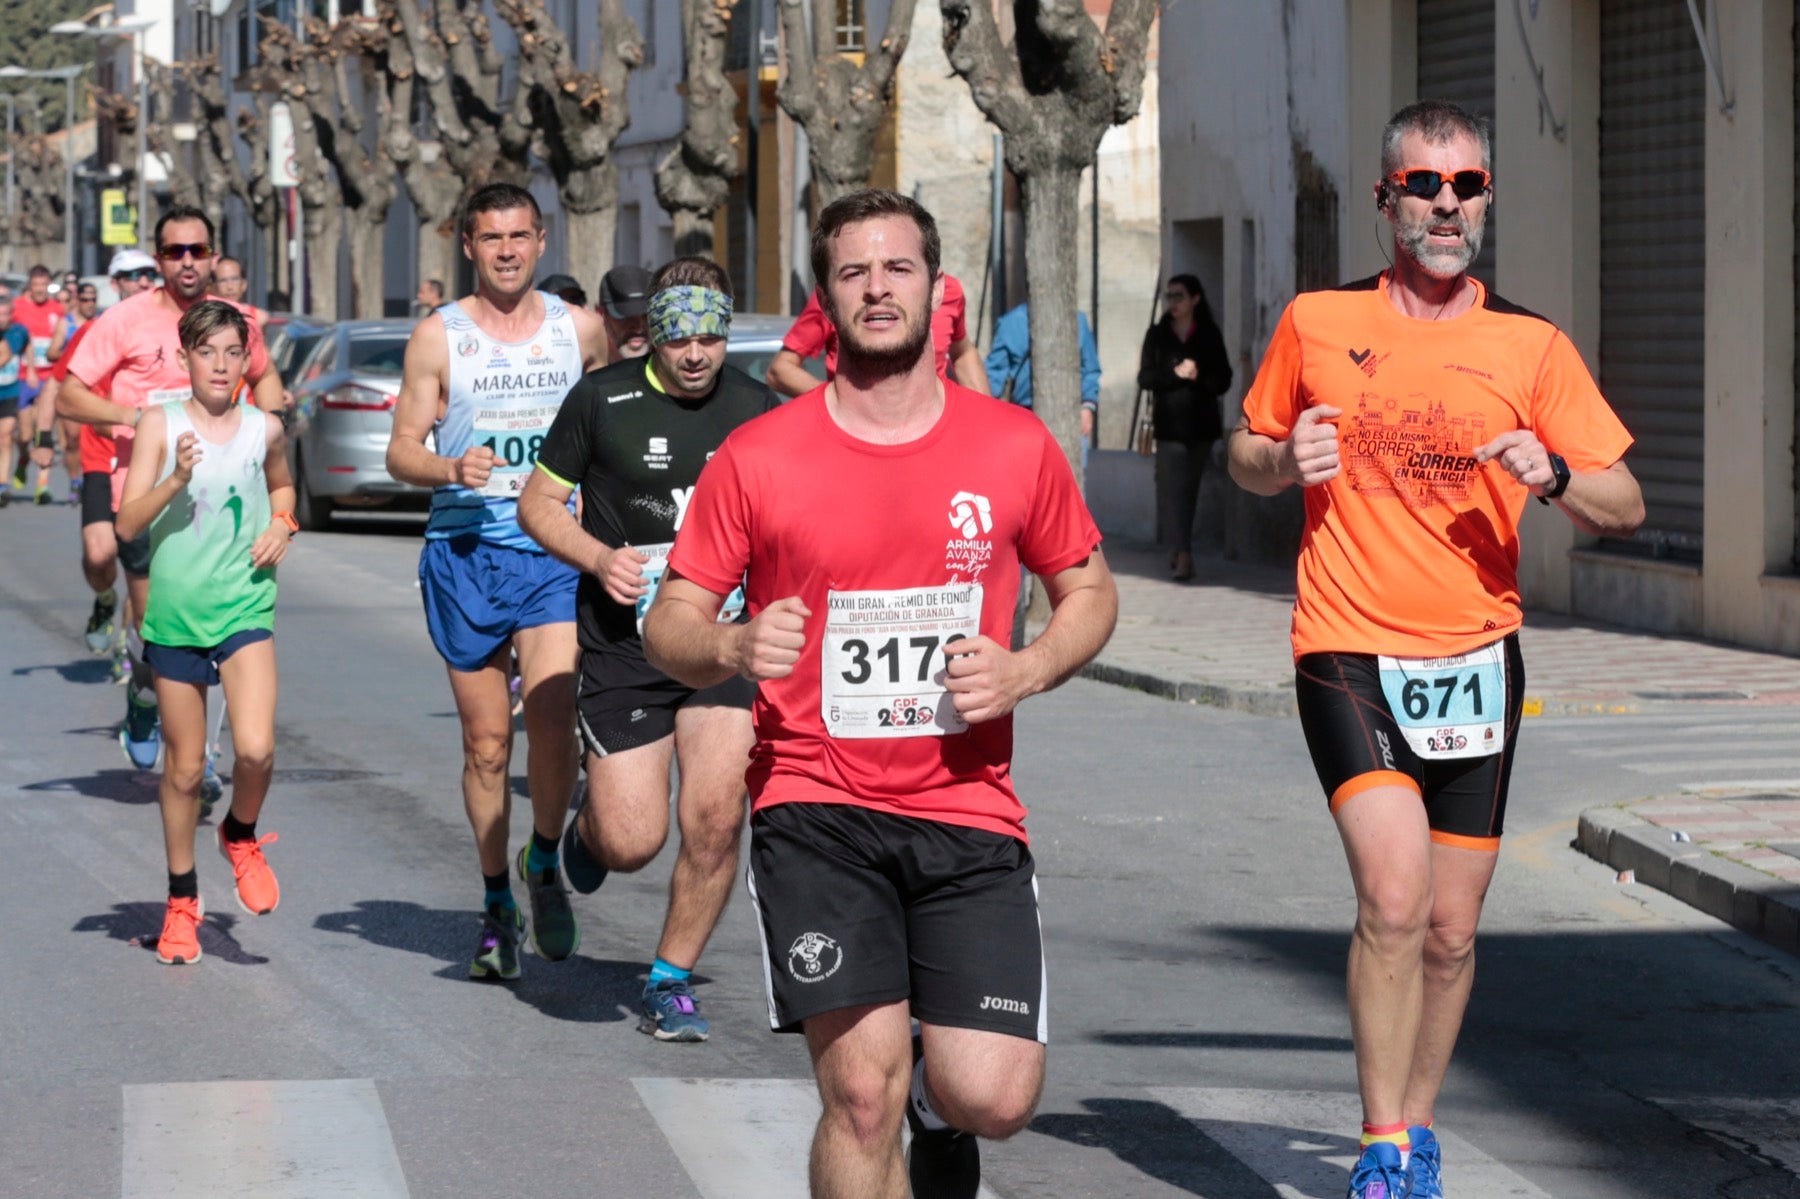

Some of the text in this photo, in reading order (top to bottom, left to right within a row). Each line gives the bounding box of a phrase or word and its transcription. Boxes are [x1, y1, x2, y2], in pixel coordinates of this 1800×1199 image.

[1456, 365, 1493, 380] BROOKS
[472, 370, 568, 393] MARACENA
[1358, 430, 1430, 442] NO ES LO MISMO
[1357, 440, 1416, 457] CORRER
[643, 454, 673, 462] SEAT
[1407, 452, 1478, 472] CORRER
[1394, 468, 1468, 482] EN VALENCIA
[946, 539, 992, 550] ARMILLA
[946, 550, 991, 560] AVANZA
[829, 590, 970, 610] XXXIII GRAN REMIO DE FONDO
[902, 609, 912, 620] DE
[915, 606, 955, 619] GRANADA
[894, 697, 918, 710] GDE
[1402, 672, 1482, 721] 671
[980, 996, 1030, 1015] Joma
